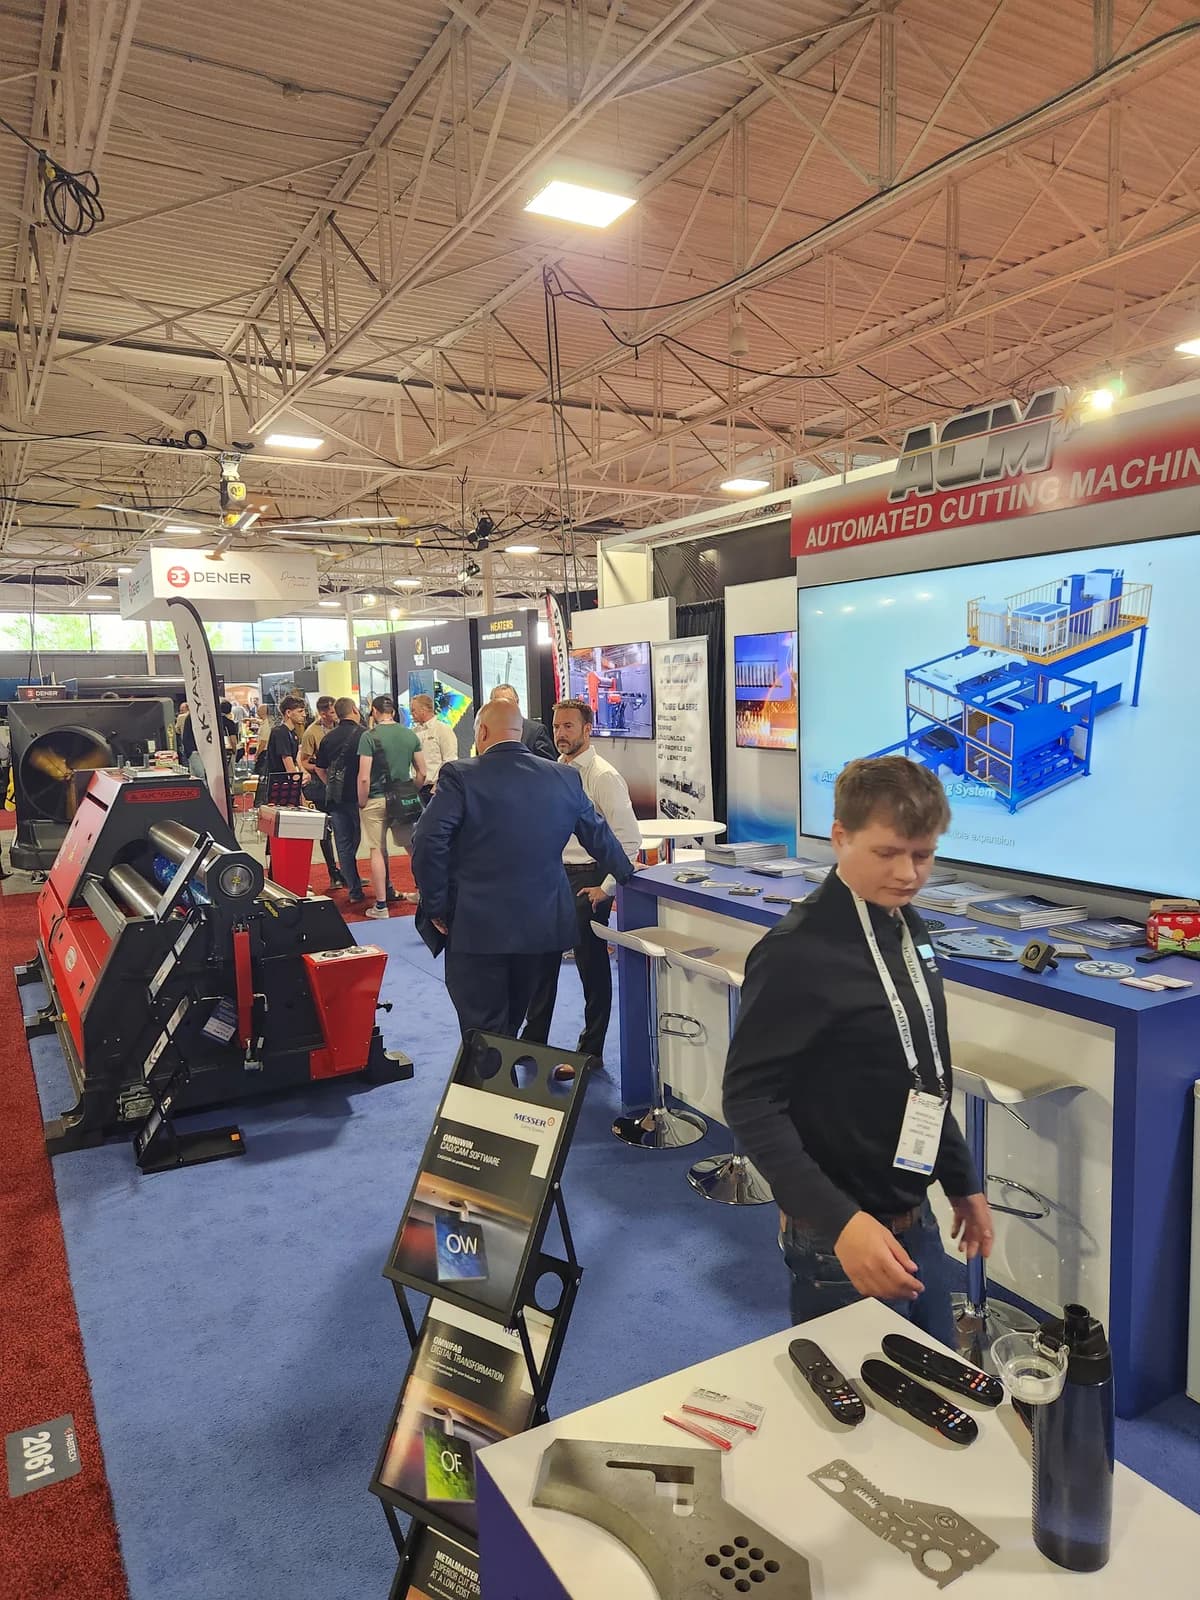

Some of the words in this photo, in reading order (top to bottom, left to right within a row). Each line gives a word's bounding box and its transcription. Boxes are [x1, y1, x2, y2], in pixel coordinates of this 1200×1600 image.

[888, 386, 1070, 503] ACM
[805, 503, 932, 549] AUTOMATED
[939, 477, 1061, 524] CUTTING
[193, 571, 252, 585] DENER
[490, 619, 514, 632] HEATERS
[183, 632, 212, 745] AKYAPAK
[955, 783, 996, 800] System
[895, 1002, 912, 1049] FABTECH
[513, 1112, 547, 1128] MESSER
[440, 1141, 470, 1157] CAD/CAM
[468, 1149, 501, 1167] SOFTWARE
[446, 1232, 478, 1255] OW
[433, 1336, 463, 1354] OMNIFAB
[430, 1344, 453, 1361] DIGITAL
[452, 1352, 505, 1383] TRANSFORMATION
[22, 1431, 56, 1482] 2061
[441, 1450, 464, 1473] OF
[433, 1559, 459, 1582] SUPERIOR
[457, 1573, 471, 1588] CUT
[435, 1550, 479, 1582] METALMASTER
[430, 1569, 439, 1580] AT
[437, 1574, 443, 1583] A
[442, 1577, 457, 1590] LOW
[455, 1584, 471, 1599] COST
